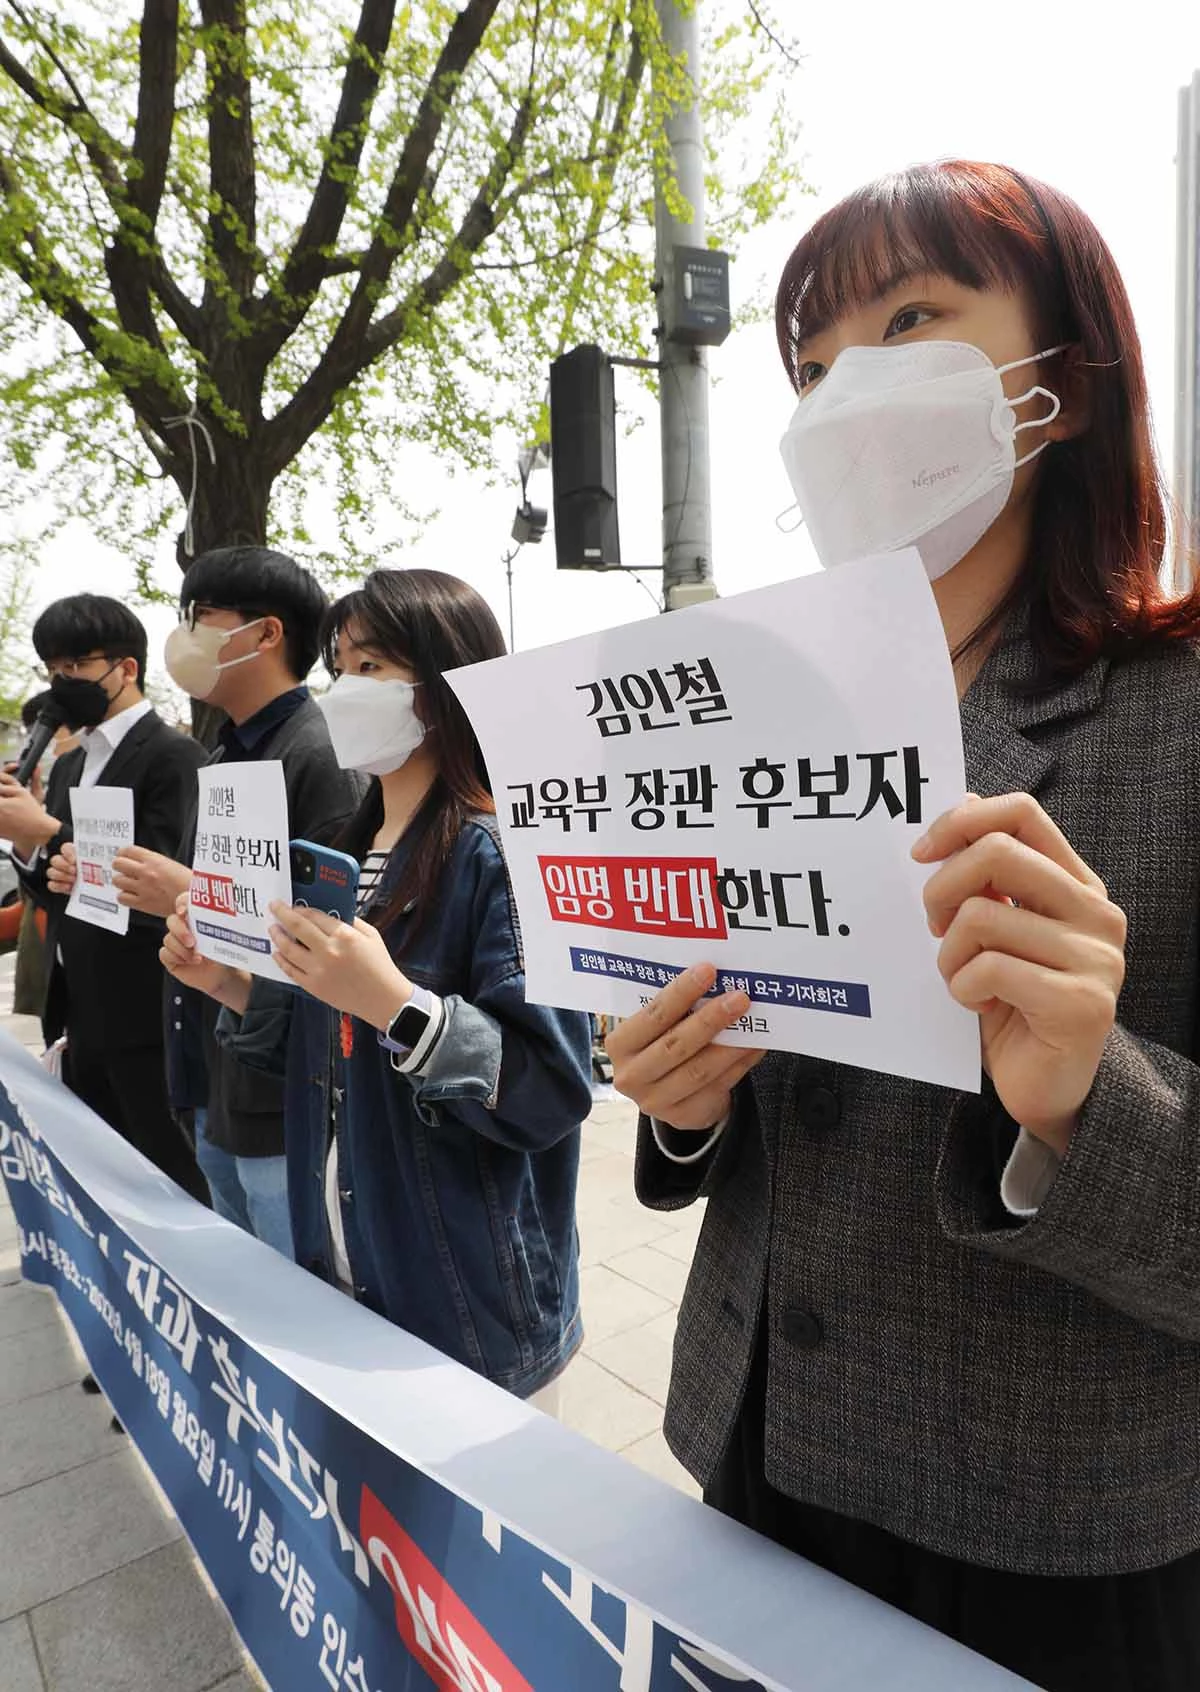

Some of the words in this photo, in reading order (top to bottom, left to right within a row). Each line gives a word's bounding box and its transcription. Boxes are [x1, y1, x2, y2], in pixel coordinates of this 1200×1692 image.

[575, 657, 733, 738] 김인철
[208, 786, 236, 818] 김인철
[507, 775, 612, 832] 교육부
[624, 764, 718, 831] 장관
[735, 746, 930, 829] 후보자
[211, 834, 232, 865] 장관
[235, 837, 281, 872] 후보자
[544, 863, 614, 920] 임명
[624, 865, 851, 937] 반대한다.
[579, 953, 607, 971] 김인철
[607, 958, 636, 976] 교육부
[635, 964, 656, 981] 장관
[656, 967, 679, 984] 후보
[721, 975, 750, 995] 철회
[754, 980, 783, 999] 요구
[786, 984, 849, 1008] 기자회견
[172, 1391, 216, 1488] 월요일
[216, 1458, 252, 1542] 11시
[249, 1507, 316, 1639] 통의동
